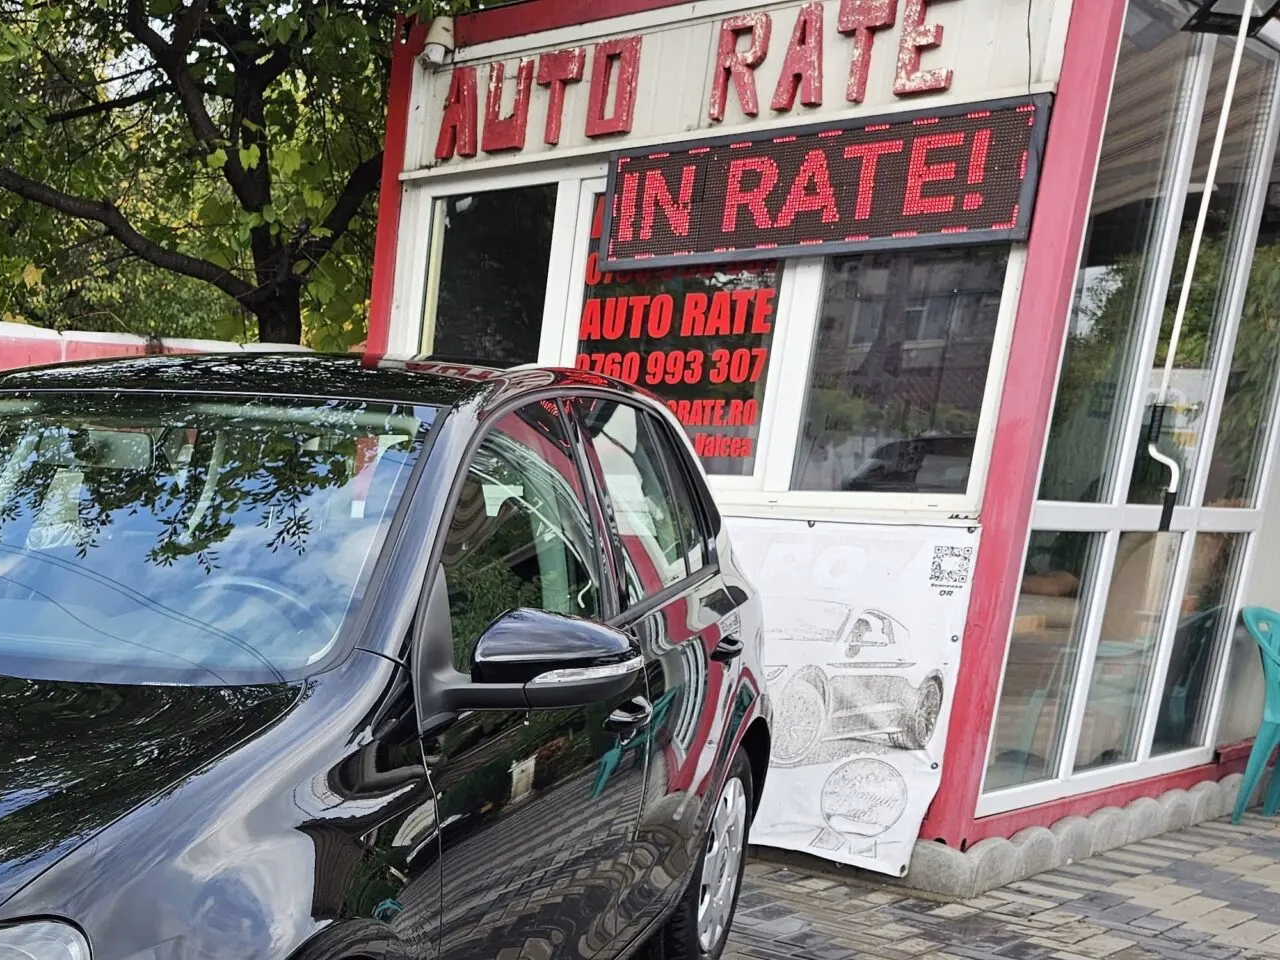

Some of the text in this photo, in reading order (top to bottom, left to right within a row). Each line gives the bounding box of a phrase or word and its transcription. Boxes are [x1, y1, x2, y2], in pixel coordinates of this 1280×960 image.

[434, 0, 954, 160] AUTO RATE
[614, 128, 992, 242] IN RATE!
[579, 288, 776, 340] AUTO RATE
[645, 350, 704, 384] 993
[709, 347, 768, 383] 307
